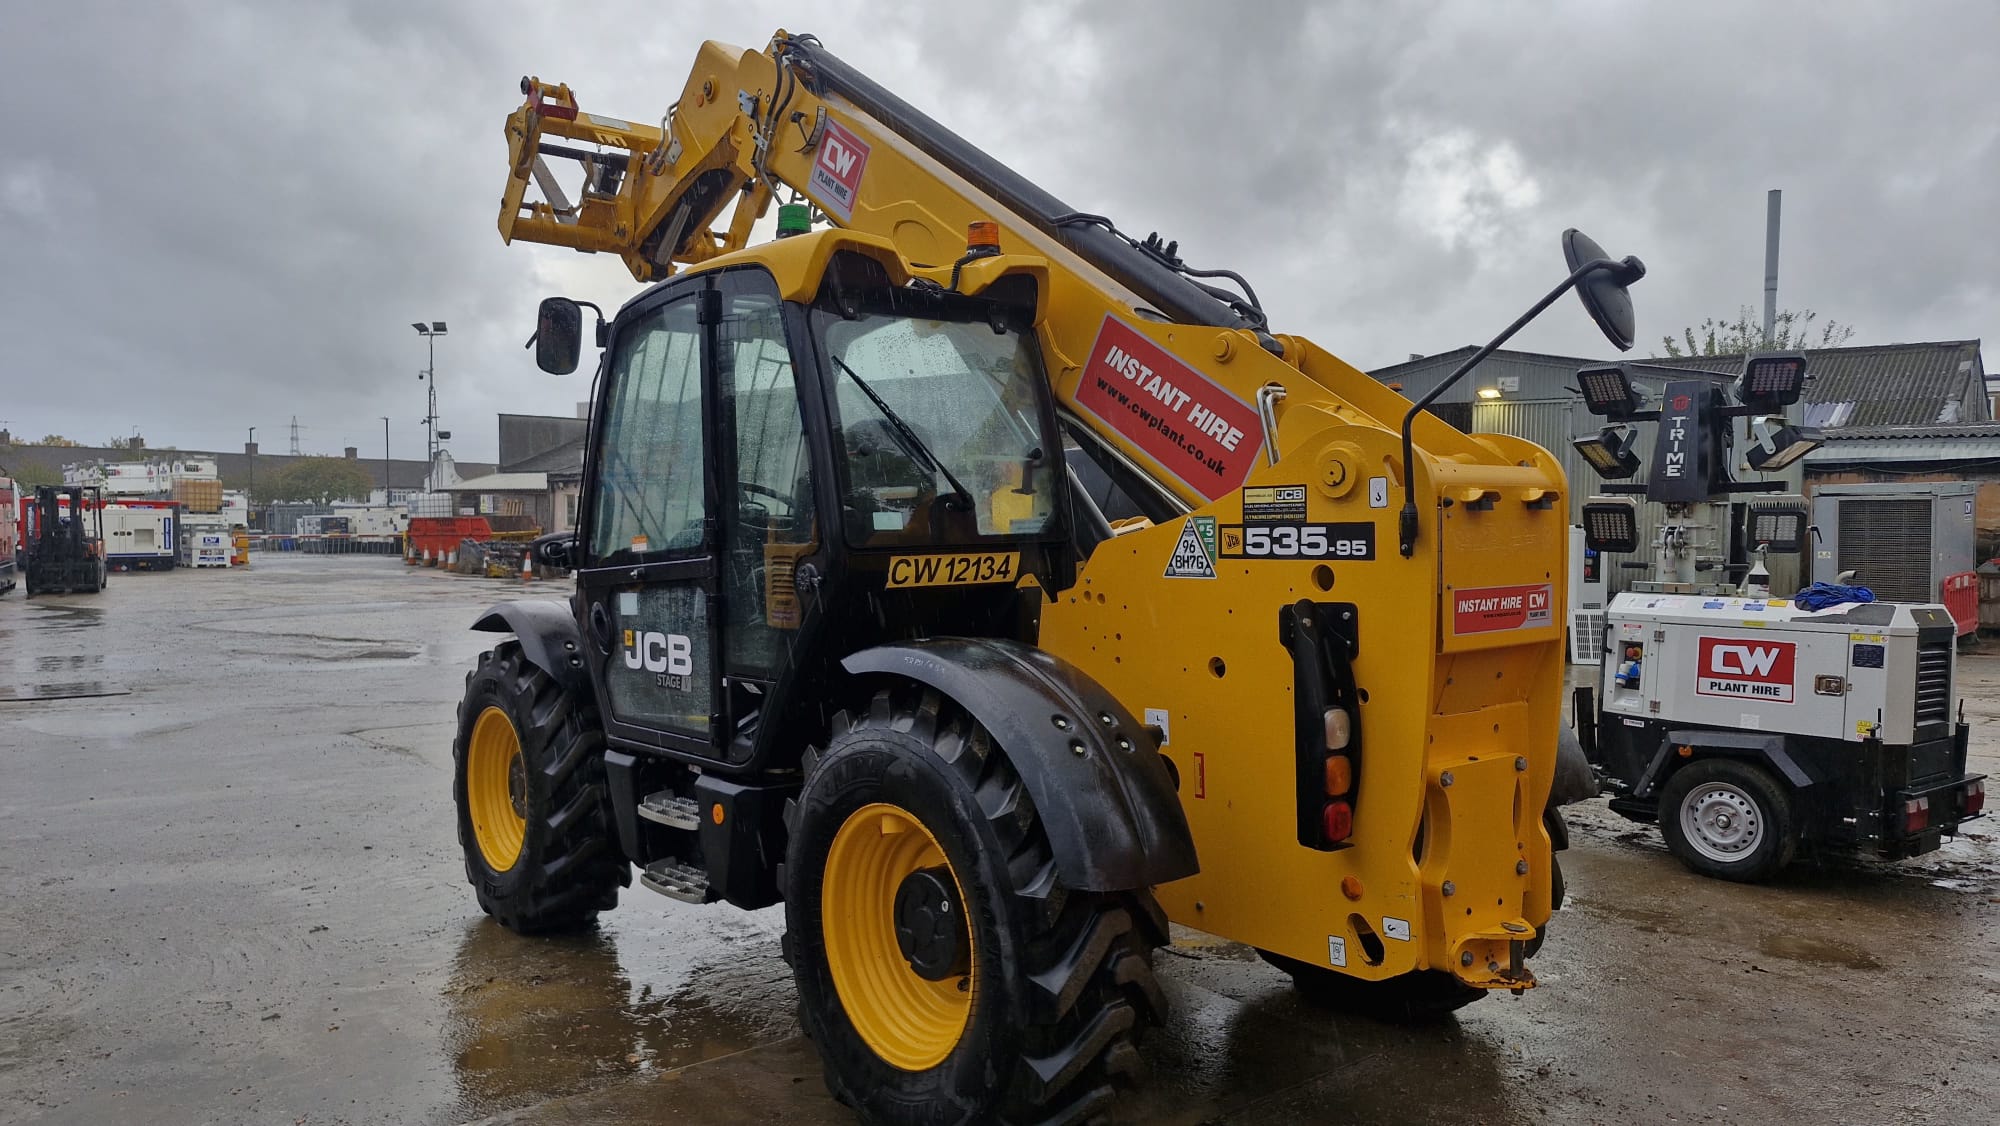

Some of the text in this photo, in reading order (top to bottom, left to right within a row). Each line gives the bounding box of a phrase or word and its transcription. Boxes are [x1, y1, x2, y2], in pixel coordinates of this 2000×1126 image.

[823, 137, 856, 178] CW
[818, 170, 848, 200] PLANT HIRE
[1104, 345, 1244, 452] INSTANT HIRE
[1097, 377, 1227, 477] www.cwplant.co.uk
[1666, 416, 1686, 477] TRIME
[1276, 490, 1303, 500] JCB
[1206, 525, 1214, 536] 5
[1245, 527, 1367, 556] 535-95
[1182, 540, 1196, 553] 96
[891, 555, 1010, 585] CW 12134
[1175, 555, 1203, 569] BH7G
[1458, 596, 1523, 613] INSTANT HIRE
[1529, 593, 1546, 608] CW
[624, 631, 693, 676] JCB
[1711, 644, 1780, 677] CW
[656, 674, 681, 689] STAGE
[1710, 681, 1780, 696] PLANT HIRE
